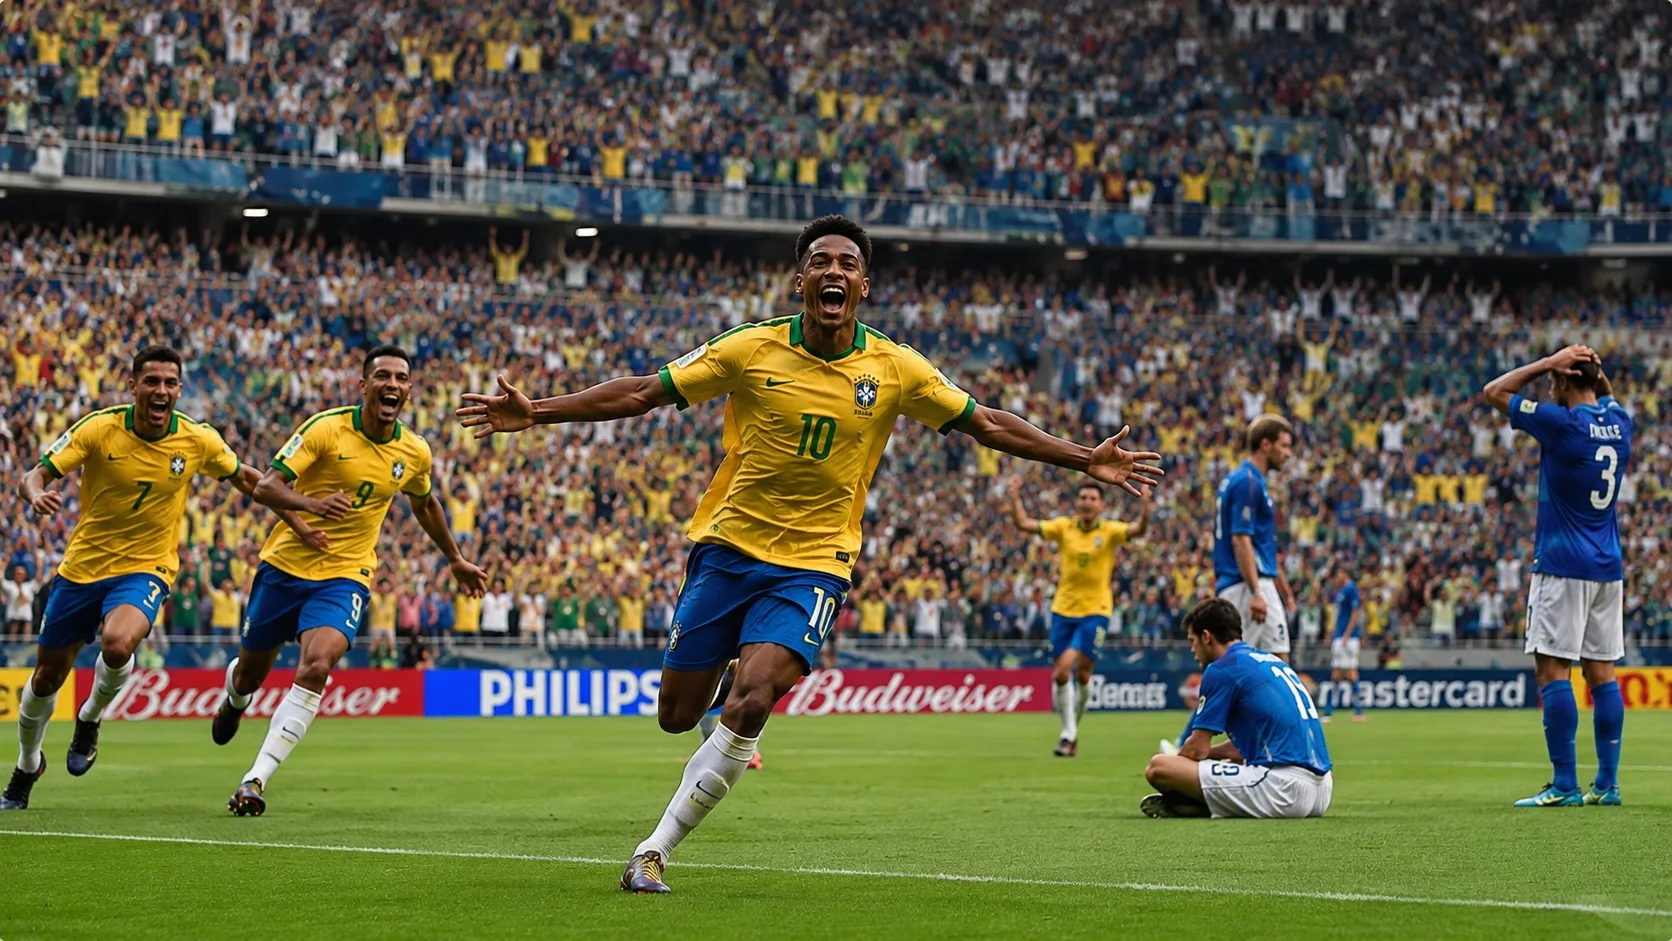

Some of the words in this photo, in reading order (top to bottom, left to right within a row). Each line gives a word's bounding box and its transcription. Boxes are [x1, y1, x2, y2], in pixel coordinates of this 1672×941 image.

[797, 413, 837, 460] 10
[132, 481, 152, 511] 7
[351, 481, 375, 509] 9
[1590, 445, 1618, 510] 3
[808, 586, 836, 640] 10
[102, 669, 401, 720] Budwser
[480, 669, 661, 716] PHILIPS
[786, 668, 1034, 716] Budweiser
[1318, 672, 1527, 708] mastercard
